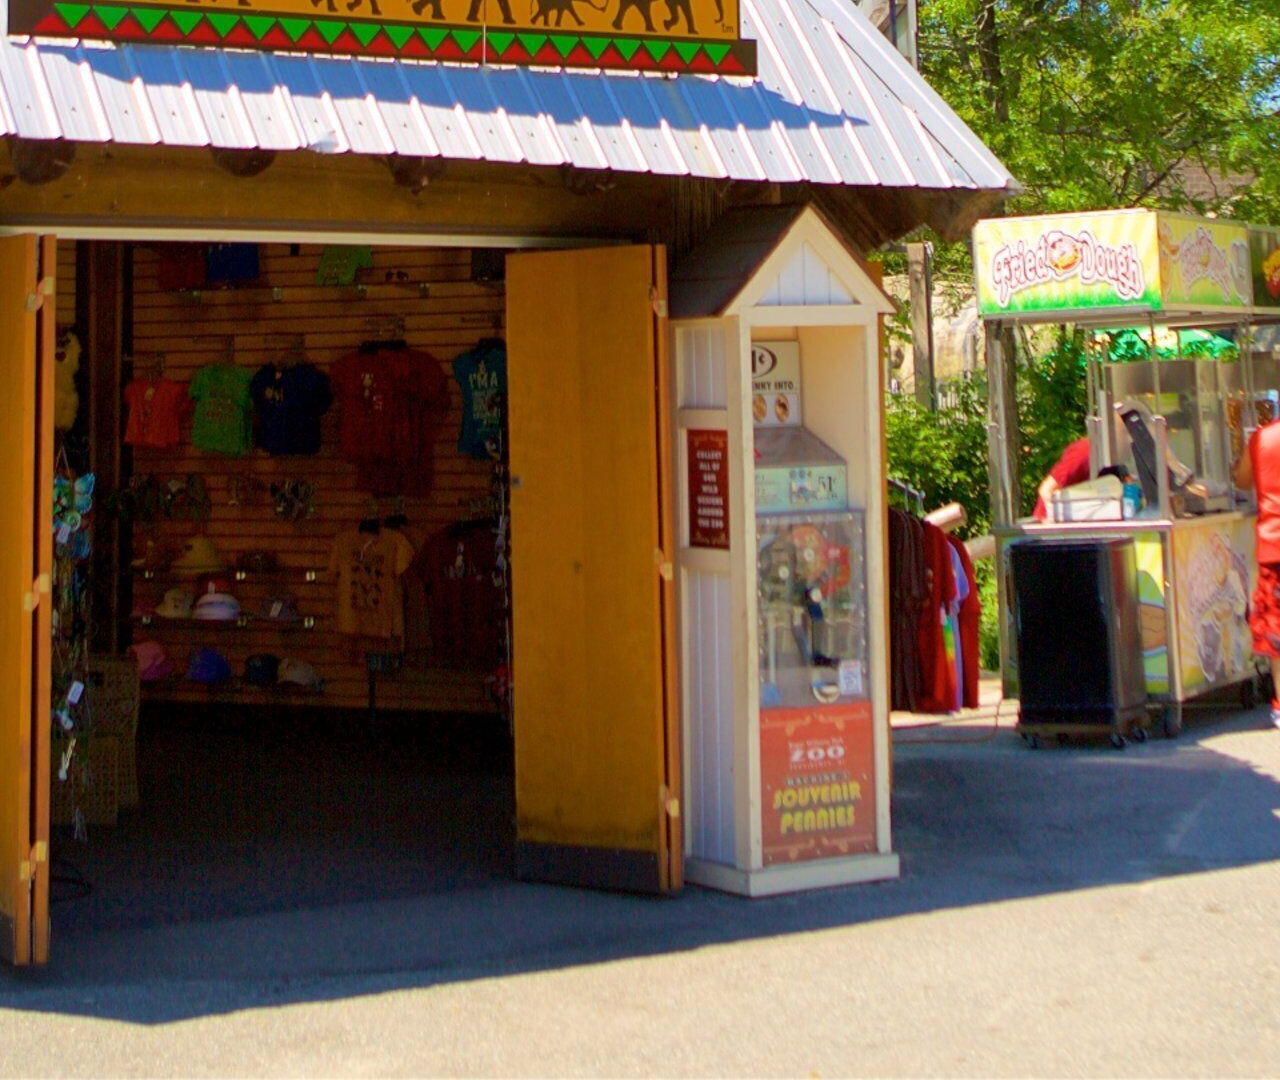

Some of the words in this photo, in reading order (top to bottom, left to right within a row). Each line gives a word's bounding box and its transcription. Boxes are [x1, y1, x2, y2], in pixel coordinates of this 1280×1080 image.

[992, 240, 1048, 303] Fried
[1080, 231, 1144, 299] Dough
[790, 745, 845, 762] ZOO
[773, 781, 862, 810] SOUVENIR
[780, 805, 856, 835] PENNIES
